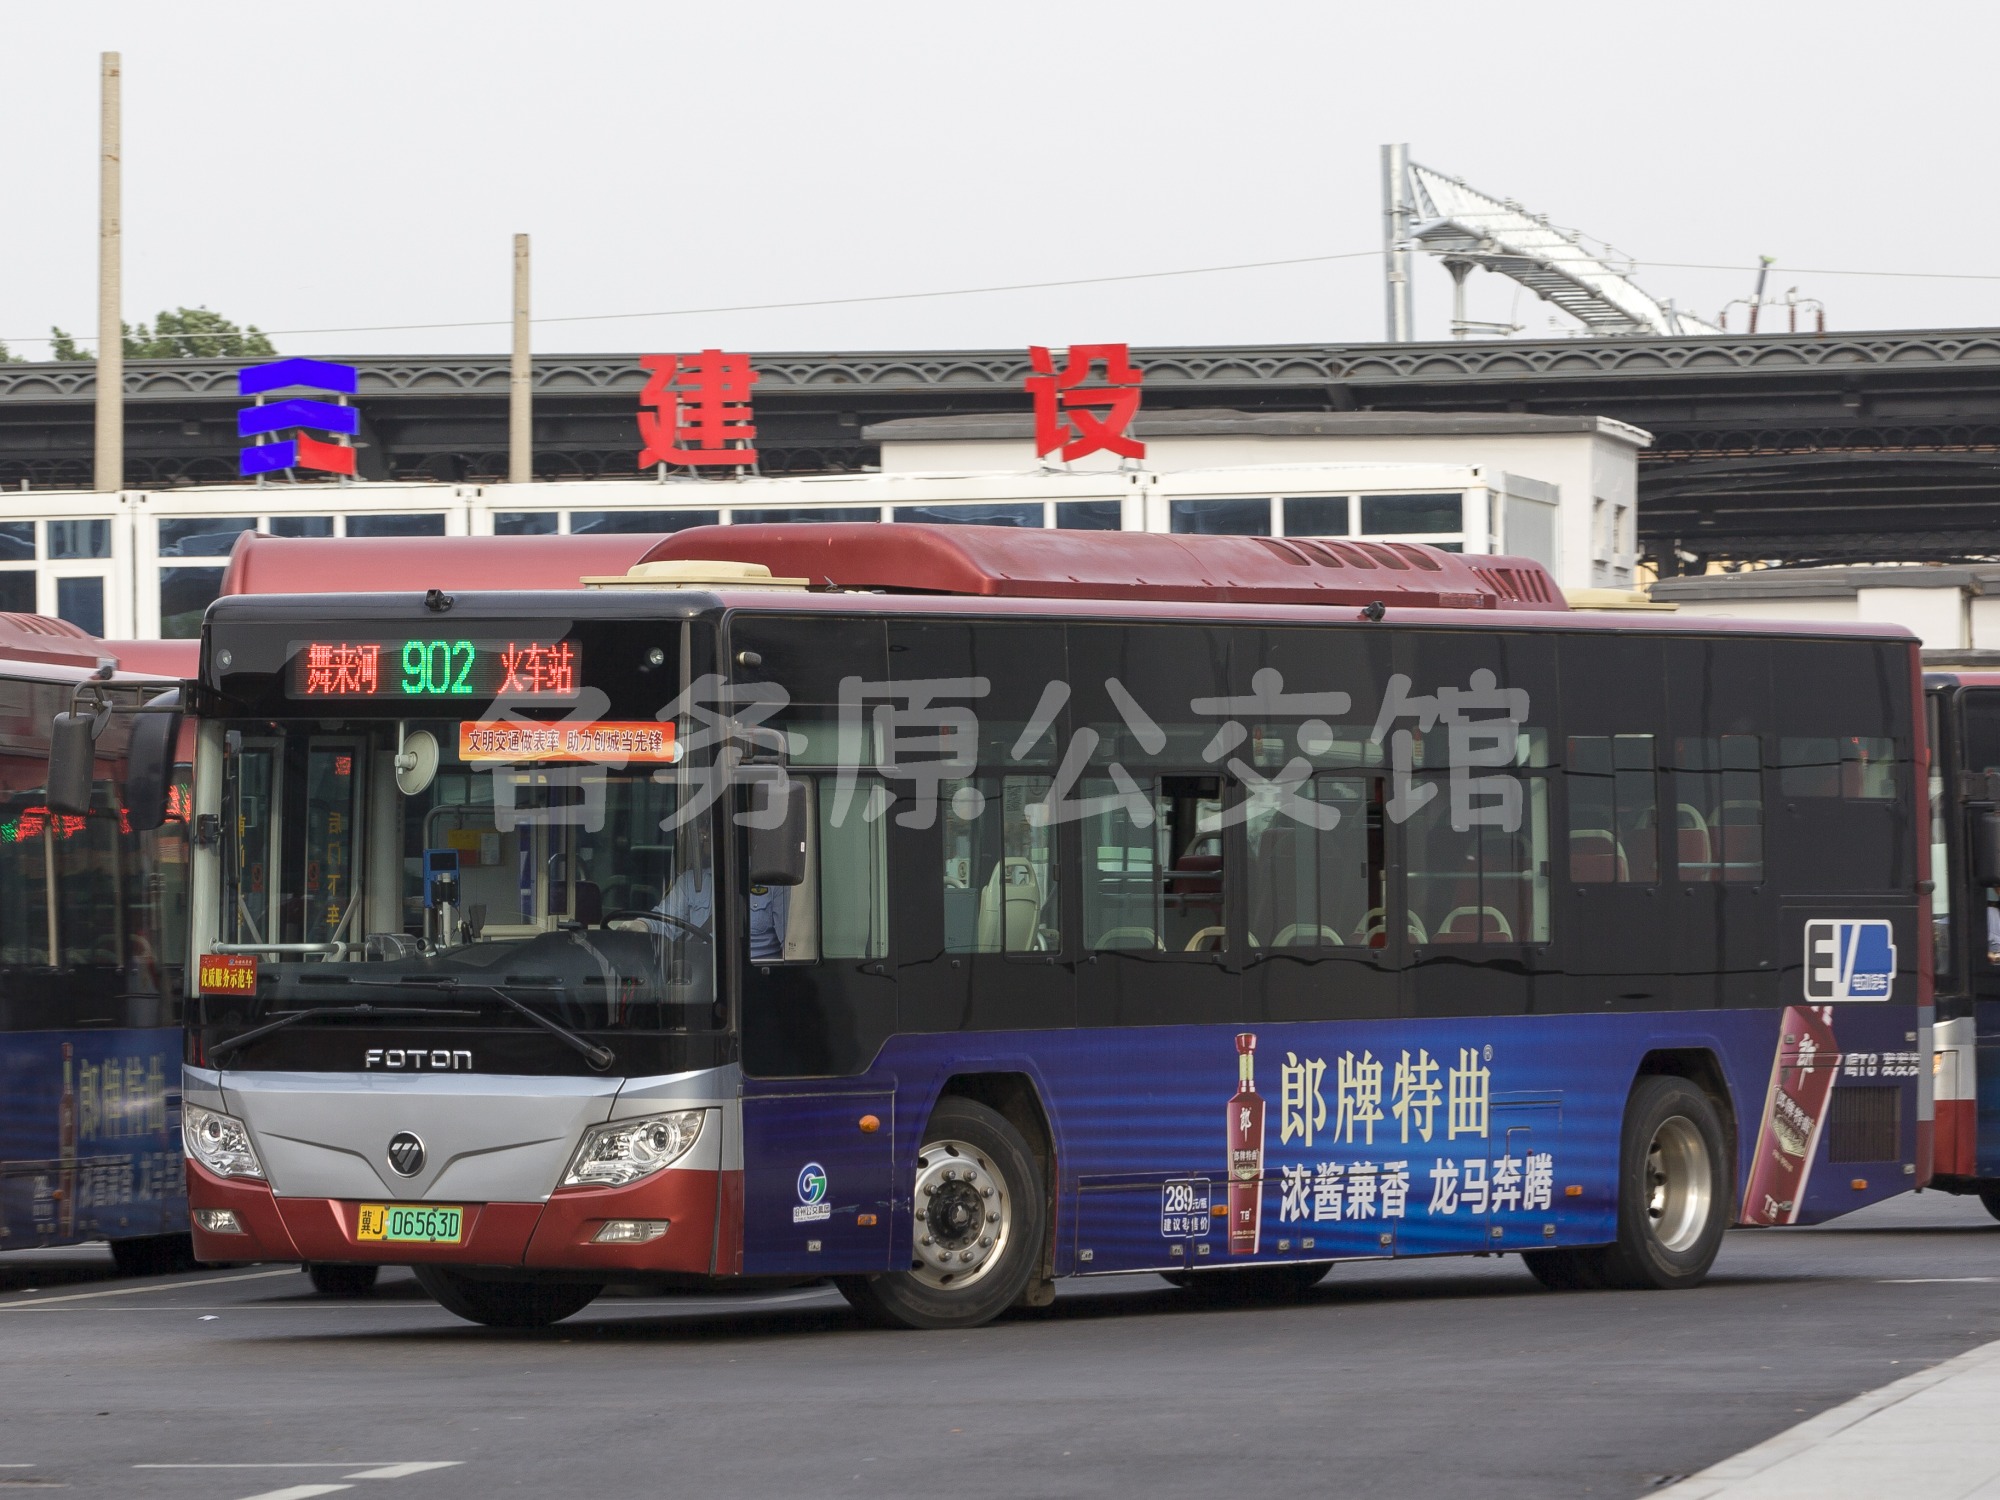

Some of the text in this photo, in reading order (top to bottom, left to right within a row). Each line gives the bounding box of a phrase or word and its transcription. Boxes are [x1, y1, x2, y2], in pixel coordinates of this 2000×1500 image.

[401, 640, 475, 694] 902
[498, 643, 574, 694] 火车站
[469, 730, 663, 752] 文明交通做表率 助力创城当先锋
[201, 967, 254, 989] 优质服务示范车
[364, 1049, 472, 1070] FOTON
[1280, 1047, 1491, 1147] 郎牌特曲
[1279, 1152, 1553, 1223] 浓酱兼香 龙马奔腾
